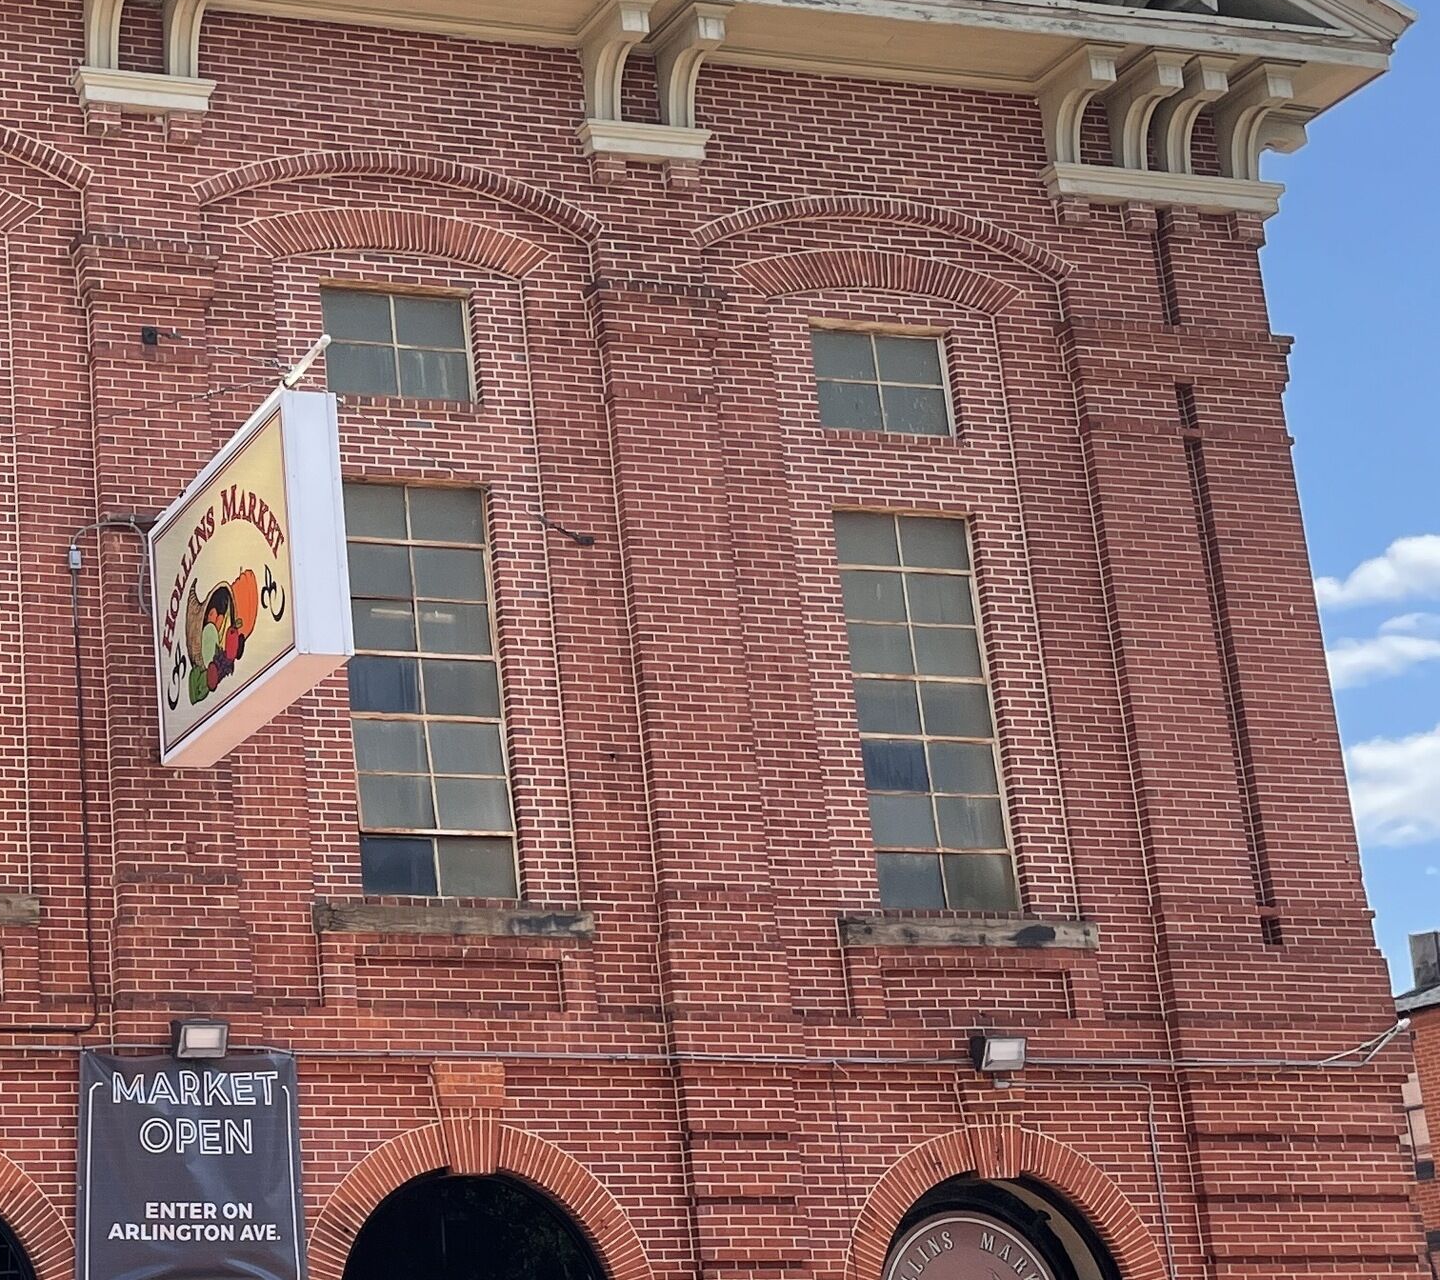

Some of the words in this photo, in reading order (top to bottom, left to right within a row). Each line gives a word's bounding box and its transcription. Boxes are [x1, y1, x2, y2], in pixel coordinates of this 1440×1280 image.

[162, 505, 216, 658] HOLLINS
[219, 483, 286, 560] MARKET
[111, 1070, 279, 1106] MARKET
[139, 1117, 253, 1155] OPEN
[145, 1202, 217, 1220] ENTER
[222, 1202, 253, 1220] ON
[108, 1223, 235, 1242] ARLINGTON
[239, 1224, 281, 1242] AVE.
